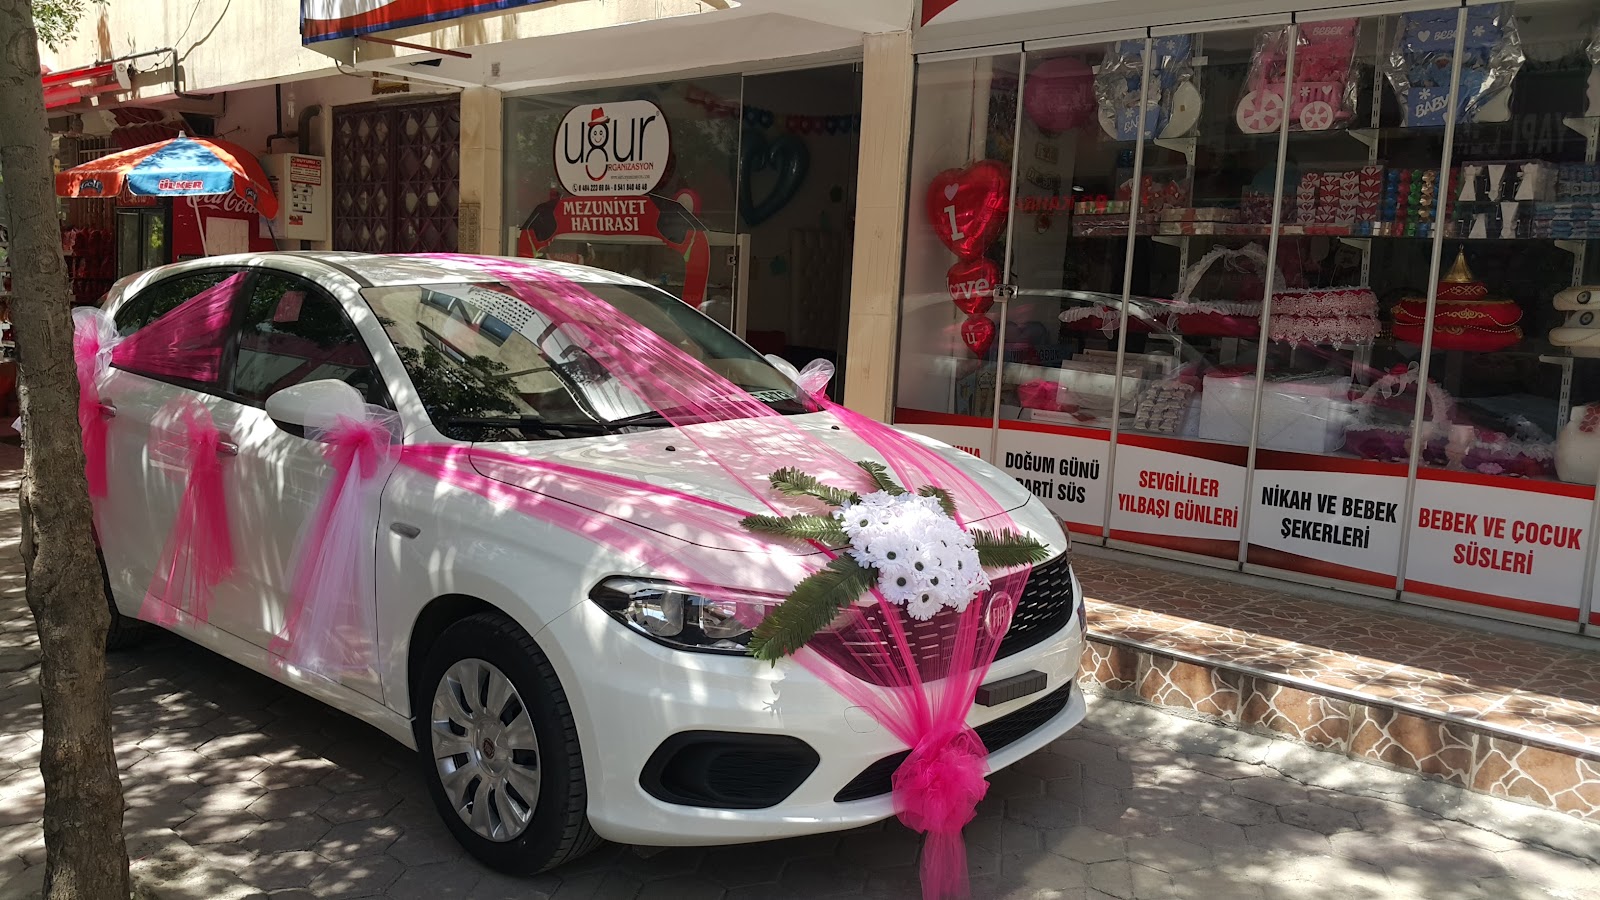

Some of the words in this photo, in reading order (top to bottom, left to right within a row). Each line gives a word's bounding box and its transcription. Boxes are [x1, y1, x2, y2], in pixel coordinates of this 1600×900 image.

[159, 179, 204, 190] ÜLKER
[563, 197, 647, 215] MEZUNİYET
[571, 217, 640, 232] HATIRASI
[953, 445, 980, 458] NA
[1005, 451, 1055, 474] DOĞUM
[1060, 457, 1099, 480] GÜNÜ
[1057, 482, 1086, 503] SÜS
[1139, 470, 1219, 497] SEVGİLİLER
[1118, 493, 1170, 518] YILBAŞI
[1174, 500, 1238, 528] GÜNLERİ
[1261, 484, 1312, 511] NİKAH
[1317, 493, 1337, 515] VE
[1342, 497, 1398, 523] BEBEK
[1280, 518, 1370, 549] ŞEKERLERİ
[1418, 507, 1478, 535] BEBEK
[1483, 516, 1506, 539] VE
[1511, 520, 1583, 550] ÇOCUK
[1453, 541, 1534, 575] SÜSLERİ
